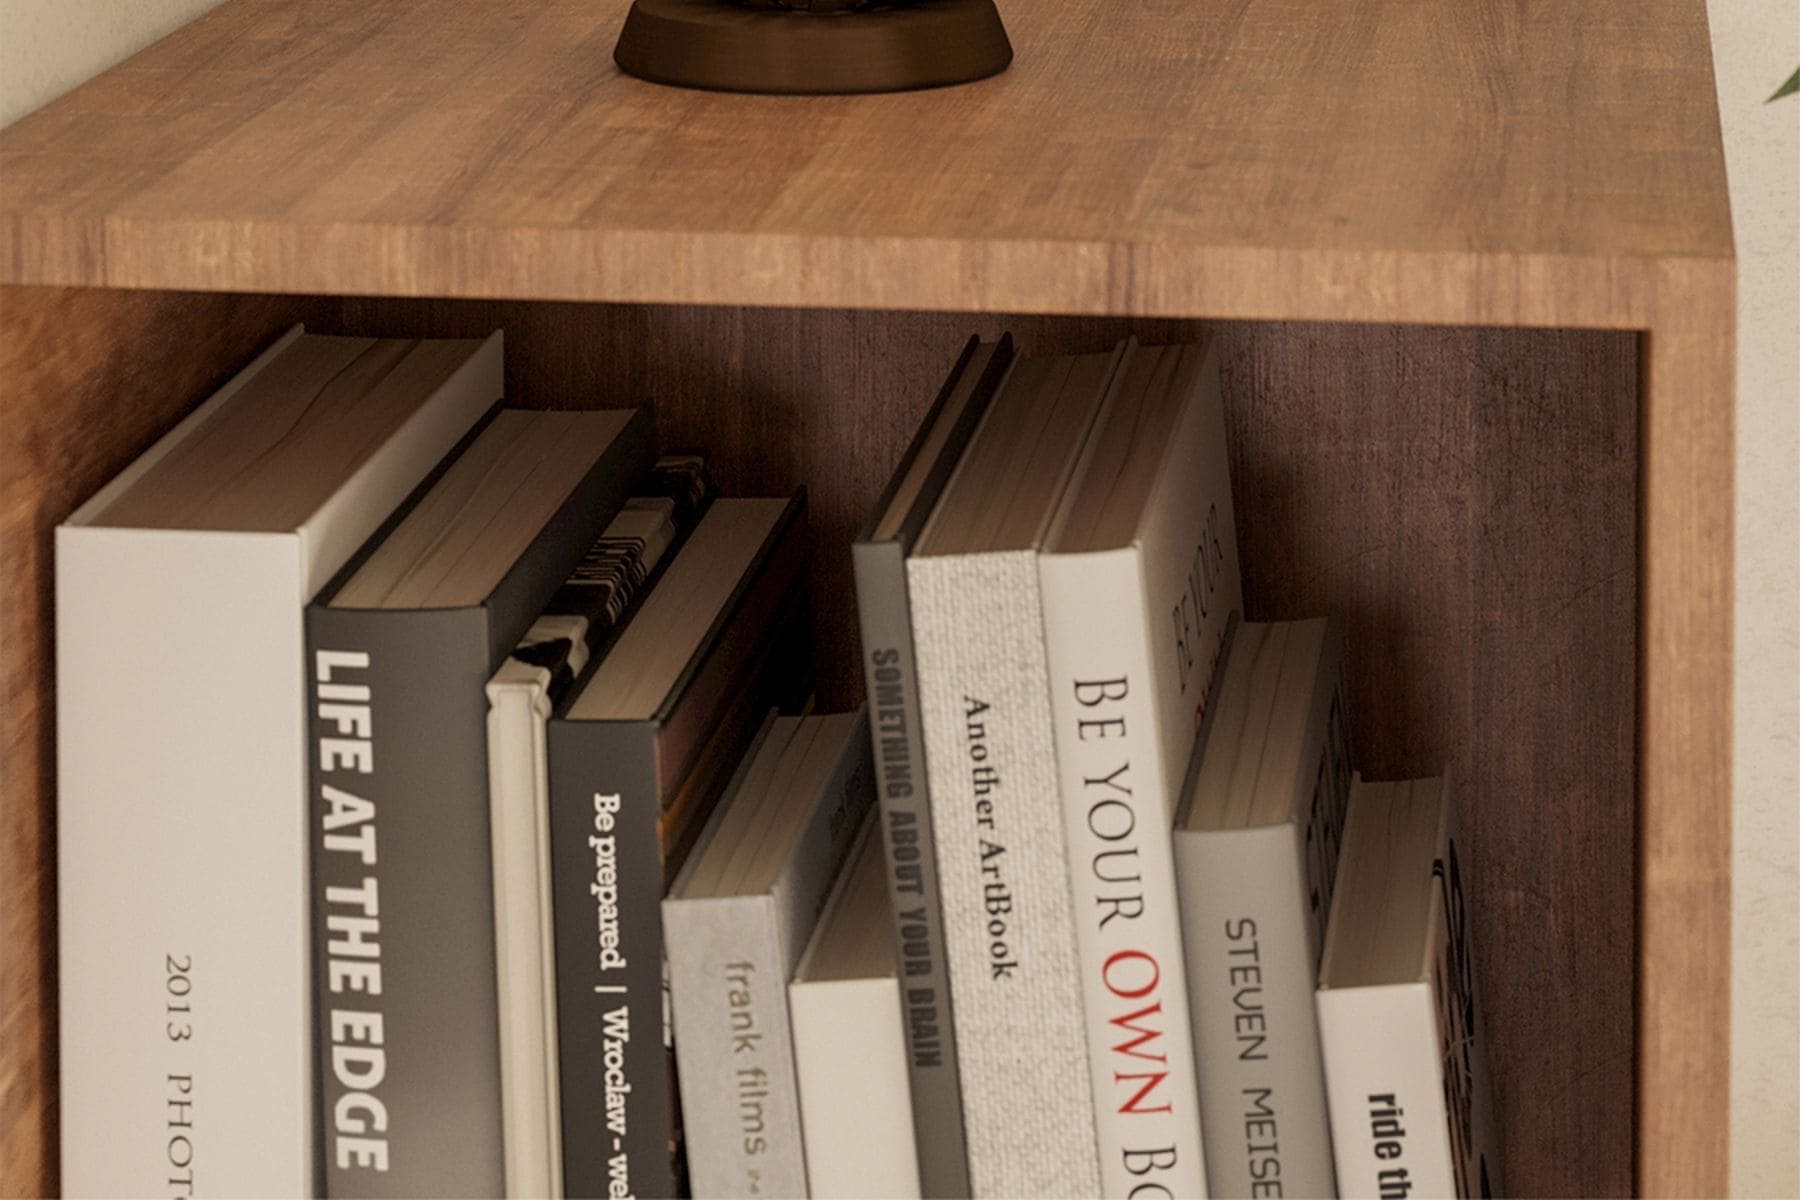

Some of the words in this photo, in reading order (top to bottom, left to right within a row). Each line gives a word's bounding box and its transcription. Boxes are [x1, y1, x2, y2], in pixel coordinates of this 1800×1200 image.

[316, 650, 373, 773] LIFE
[871, 647, 914, 799] SOMETHING
[964, 694, 1001, 831] Another
[1073, 675, 1129, 741] BE
[321, 785, 377, 865] AT
[594, 793, 621, 832] Be
[887, 810, 924, 896] ABOUT
[1083, 762, 1145, 930] YOUR
[326, 877, 382, 995] THE
[588, 835, 627, 971] prepared
[899, 907, 932, 977] YOUR
[979, 838, 1019, 981] ArtBook
[166, 954, 192, 1043] 2013
[725, 961, 763, 1053] frank
[907, 988, 942, 1068] BRAIN
[1102, 950, 1172, 1115] OWN
[1224, 918, 1270, 1062] STEVEN
[331, 1009, 389, 1172] EDGE
[602, 1006, 632, 1135] Wroclaw
[737, 1066, 769, 1156] films
[1368, 1093, 1406, 1160] ride
[167, 1073, 193, 1200] PHOT
[1242, 1087, 1283, 1200] MEISE
